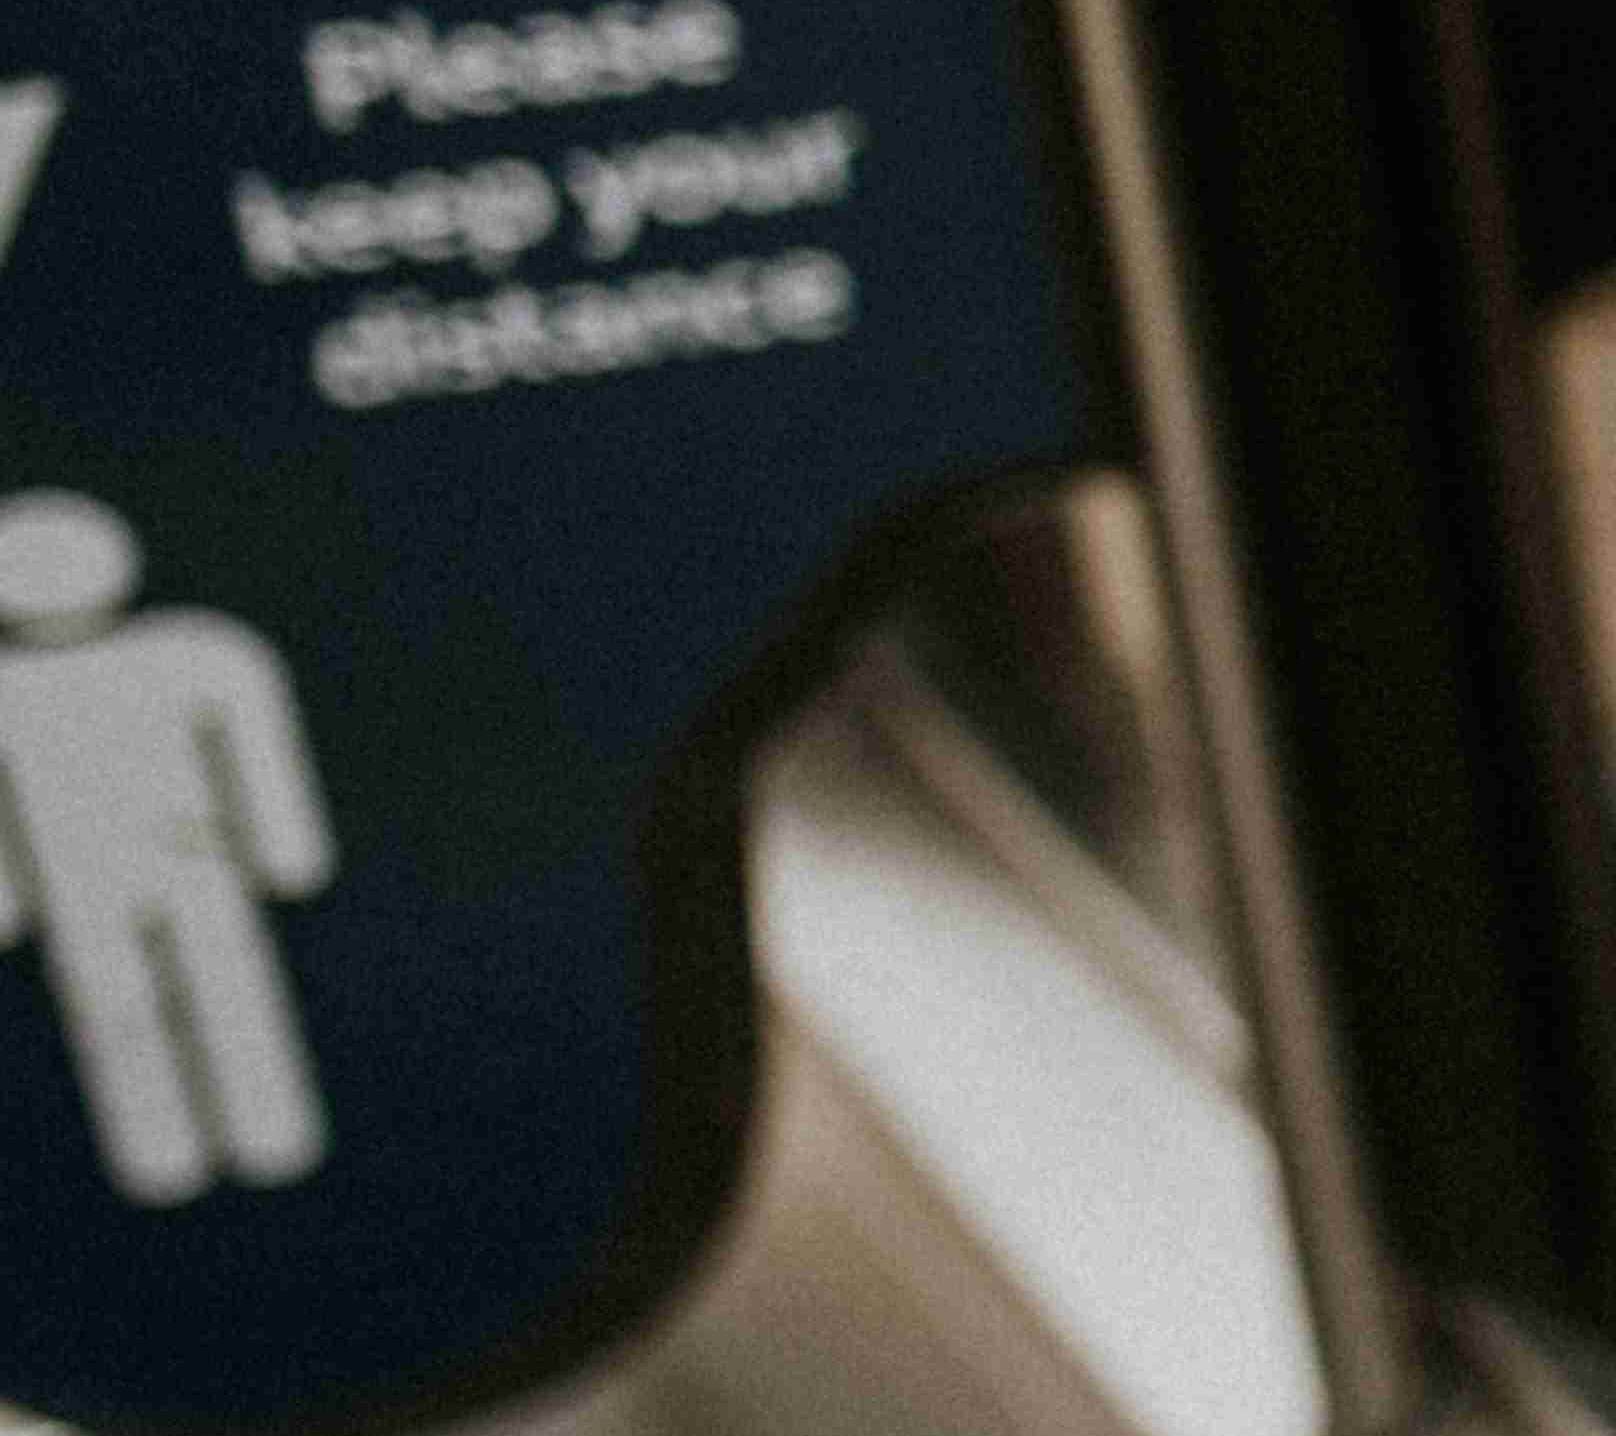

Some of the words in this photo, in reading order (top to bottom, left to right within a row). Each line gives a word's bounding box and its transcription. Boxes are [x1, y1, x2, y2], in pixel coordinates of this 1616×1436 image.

[230, 153, 563, 286] keep
[563, 105, 872, 263] your
[309, 245, 862, 411] distance
